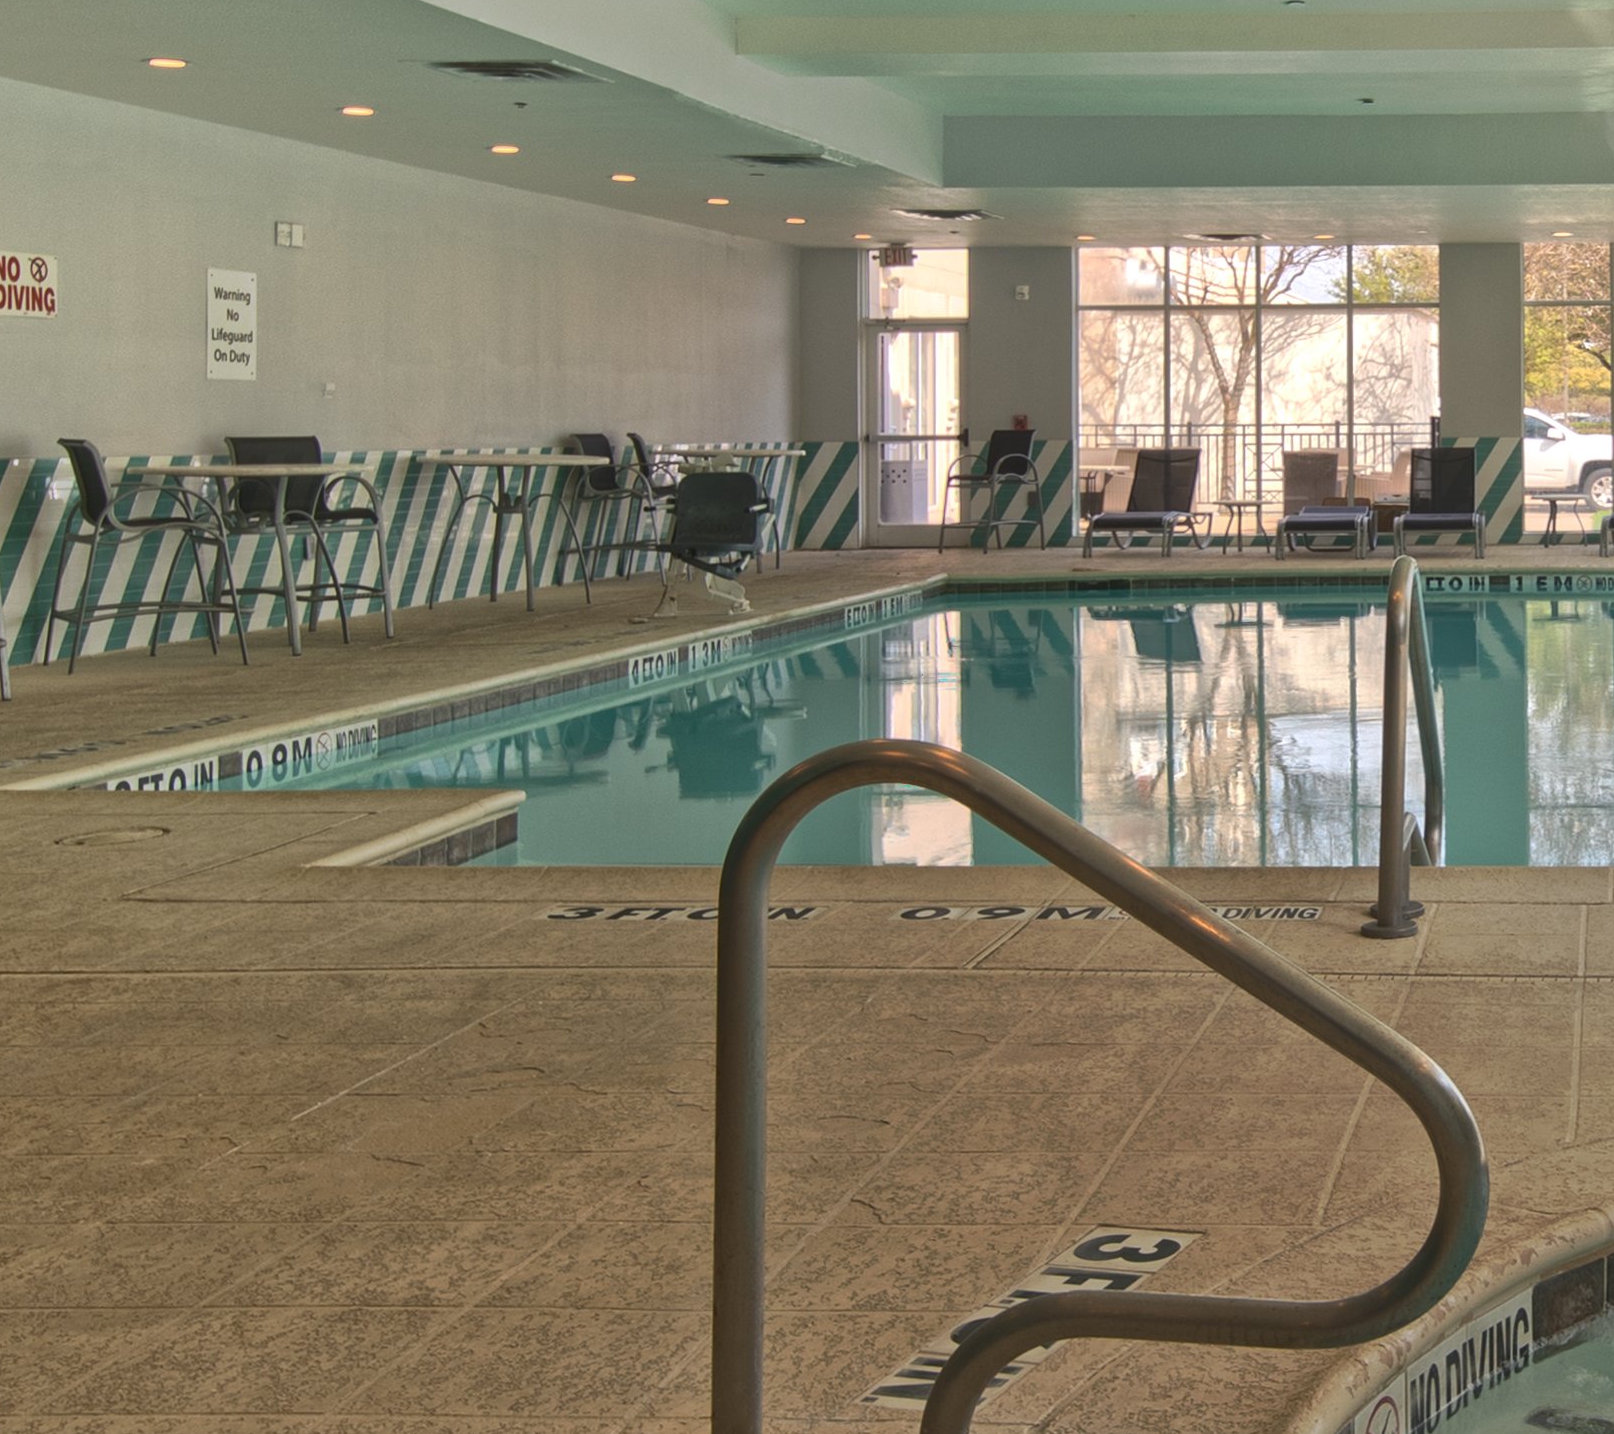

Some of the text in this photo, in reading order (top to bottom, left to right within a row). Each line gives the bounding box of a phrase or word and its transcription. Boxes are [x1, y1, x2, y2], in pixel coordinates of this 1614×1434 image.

[214, 286, 251, 306] Warning
[226, 309, 239, 322] No
[211, 328, 253, 345] Lifeguard
[214, 349, 251, 366] On Duty
[547, 907, 605, 920] 3
[1221, 908, 1320, 920] DIVING
[1073, 1234, 1181, 1264] 3
[1446, 1307, 1530, 1421] DIVING
